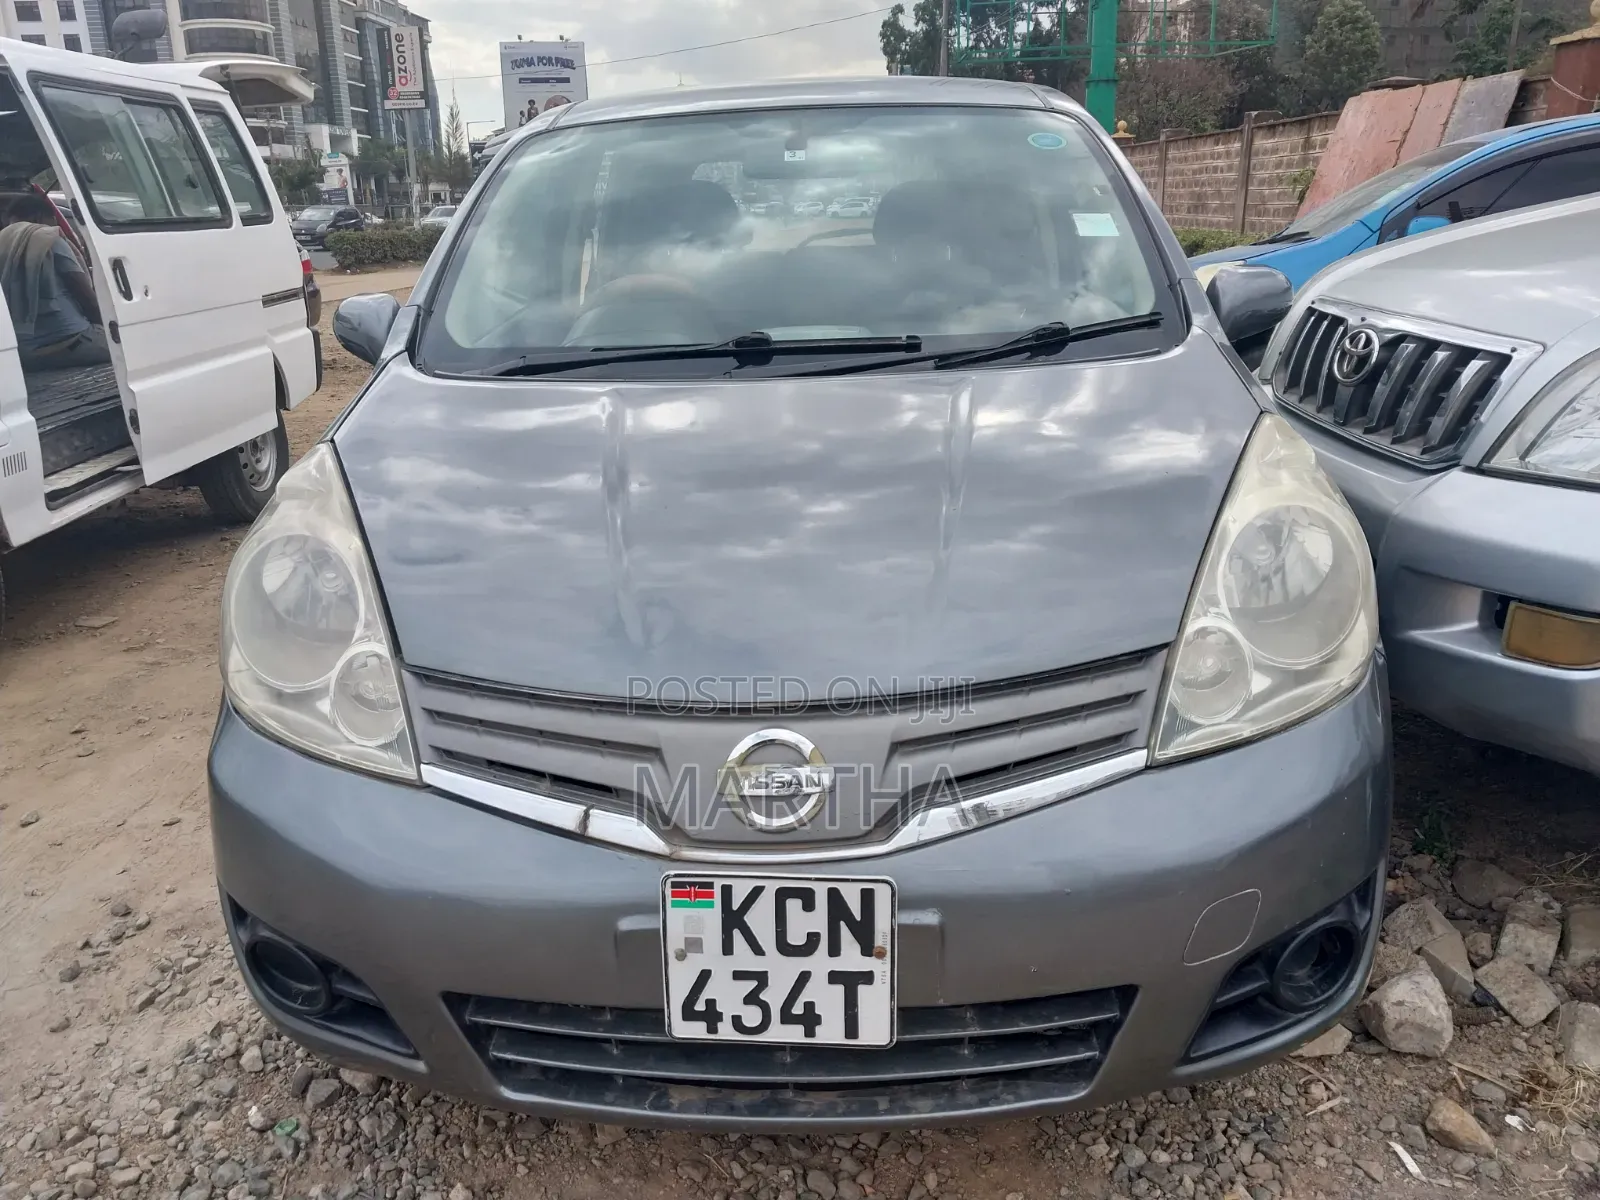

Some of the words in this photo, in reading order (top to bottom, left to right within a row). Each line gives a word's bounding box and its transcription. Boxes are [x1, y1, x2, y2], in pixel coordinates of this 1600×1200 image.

[395, 33, 409, 86] azone
[537, 56, 554, 67] FOR
[555, 56, 576, 70] FREE
[742, 773, 823, 790] ISSAN
[721, 884, 875, 958] KCN
[682, 968, 875, 1039] 434T
